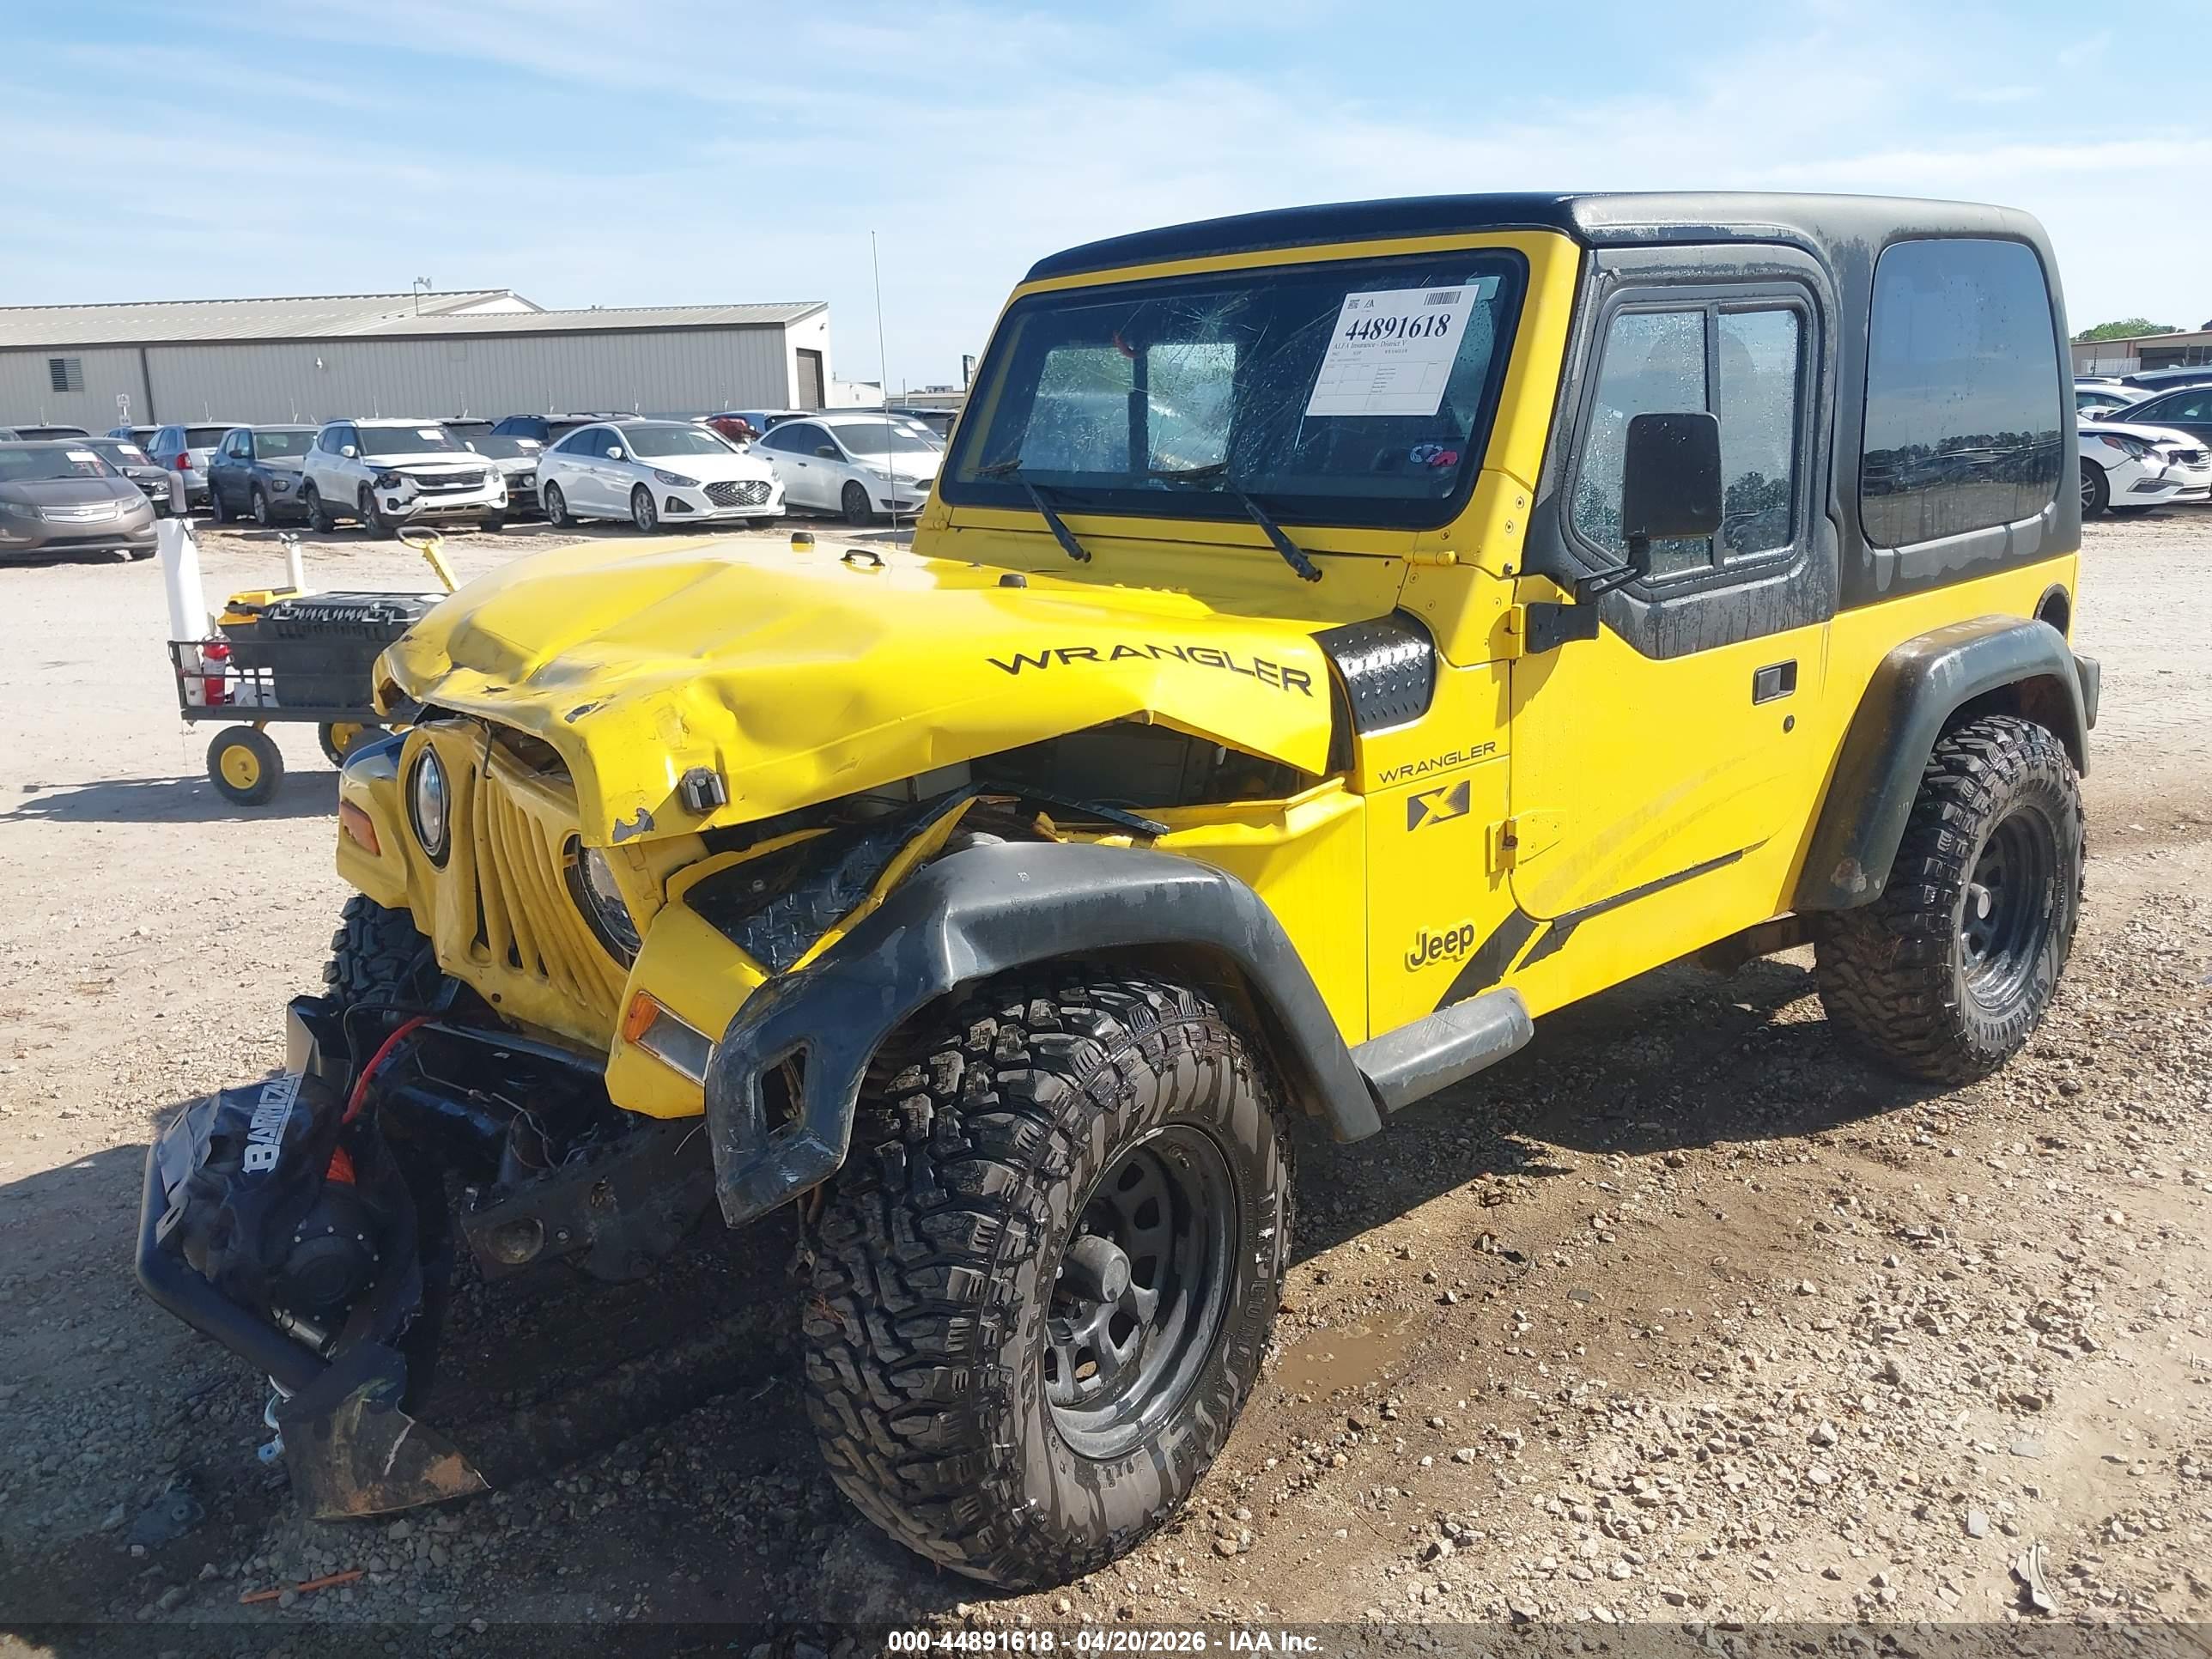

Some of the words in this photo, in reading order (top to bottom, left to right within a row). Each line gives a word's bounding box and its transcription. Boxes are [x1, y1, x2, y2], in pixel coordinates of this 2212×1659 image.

[1345, 313, 1451, 341] 44891618
[985, 644, 1314, 697] WRANGLER
[1379, 741, 1497, 785] WRANGLER
[1409, 923, 1475, 967] Jeep
